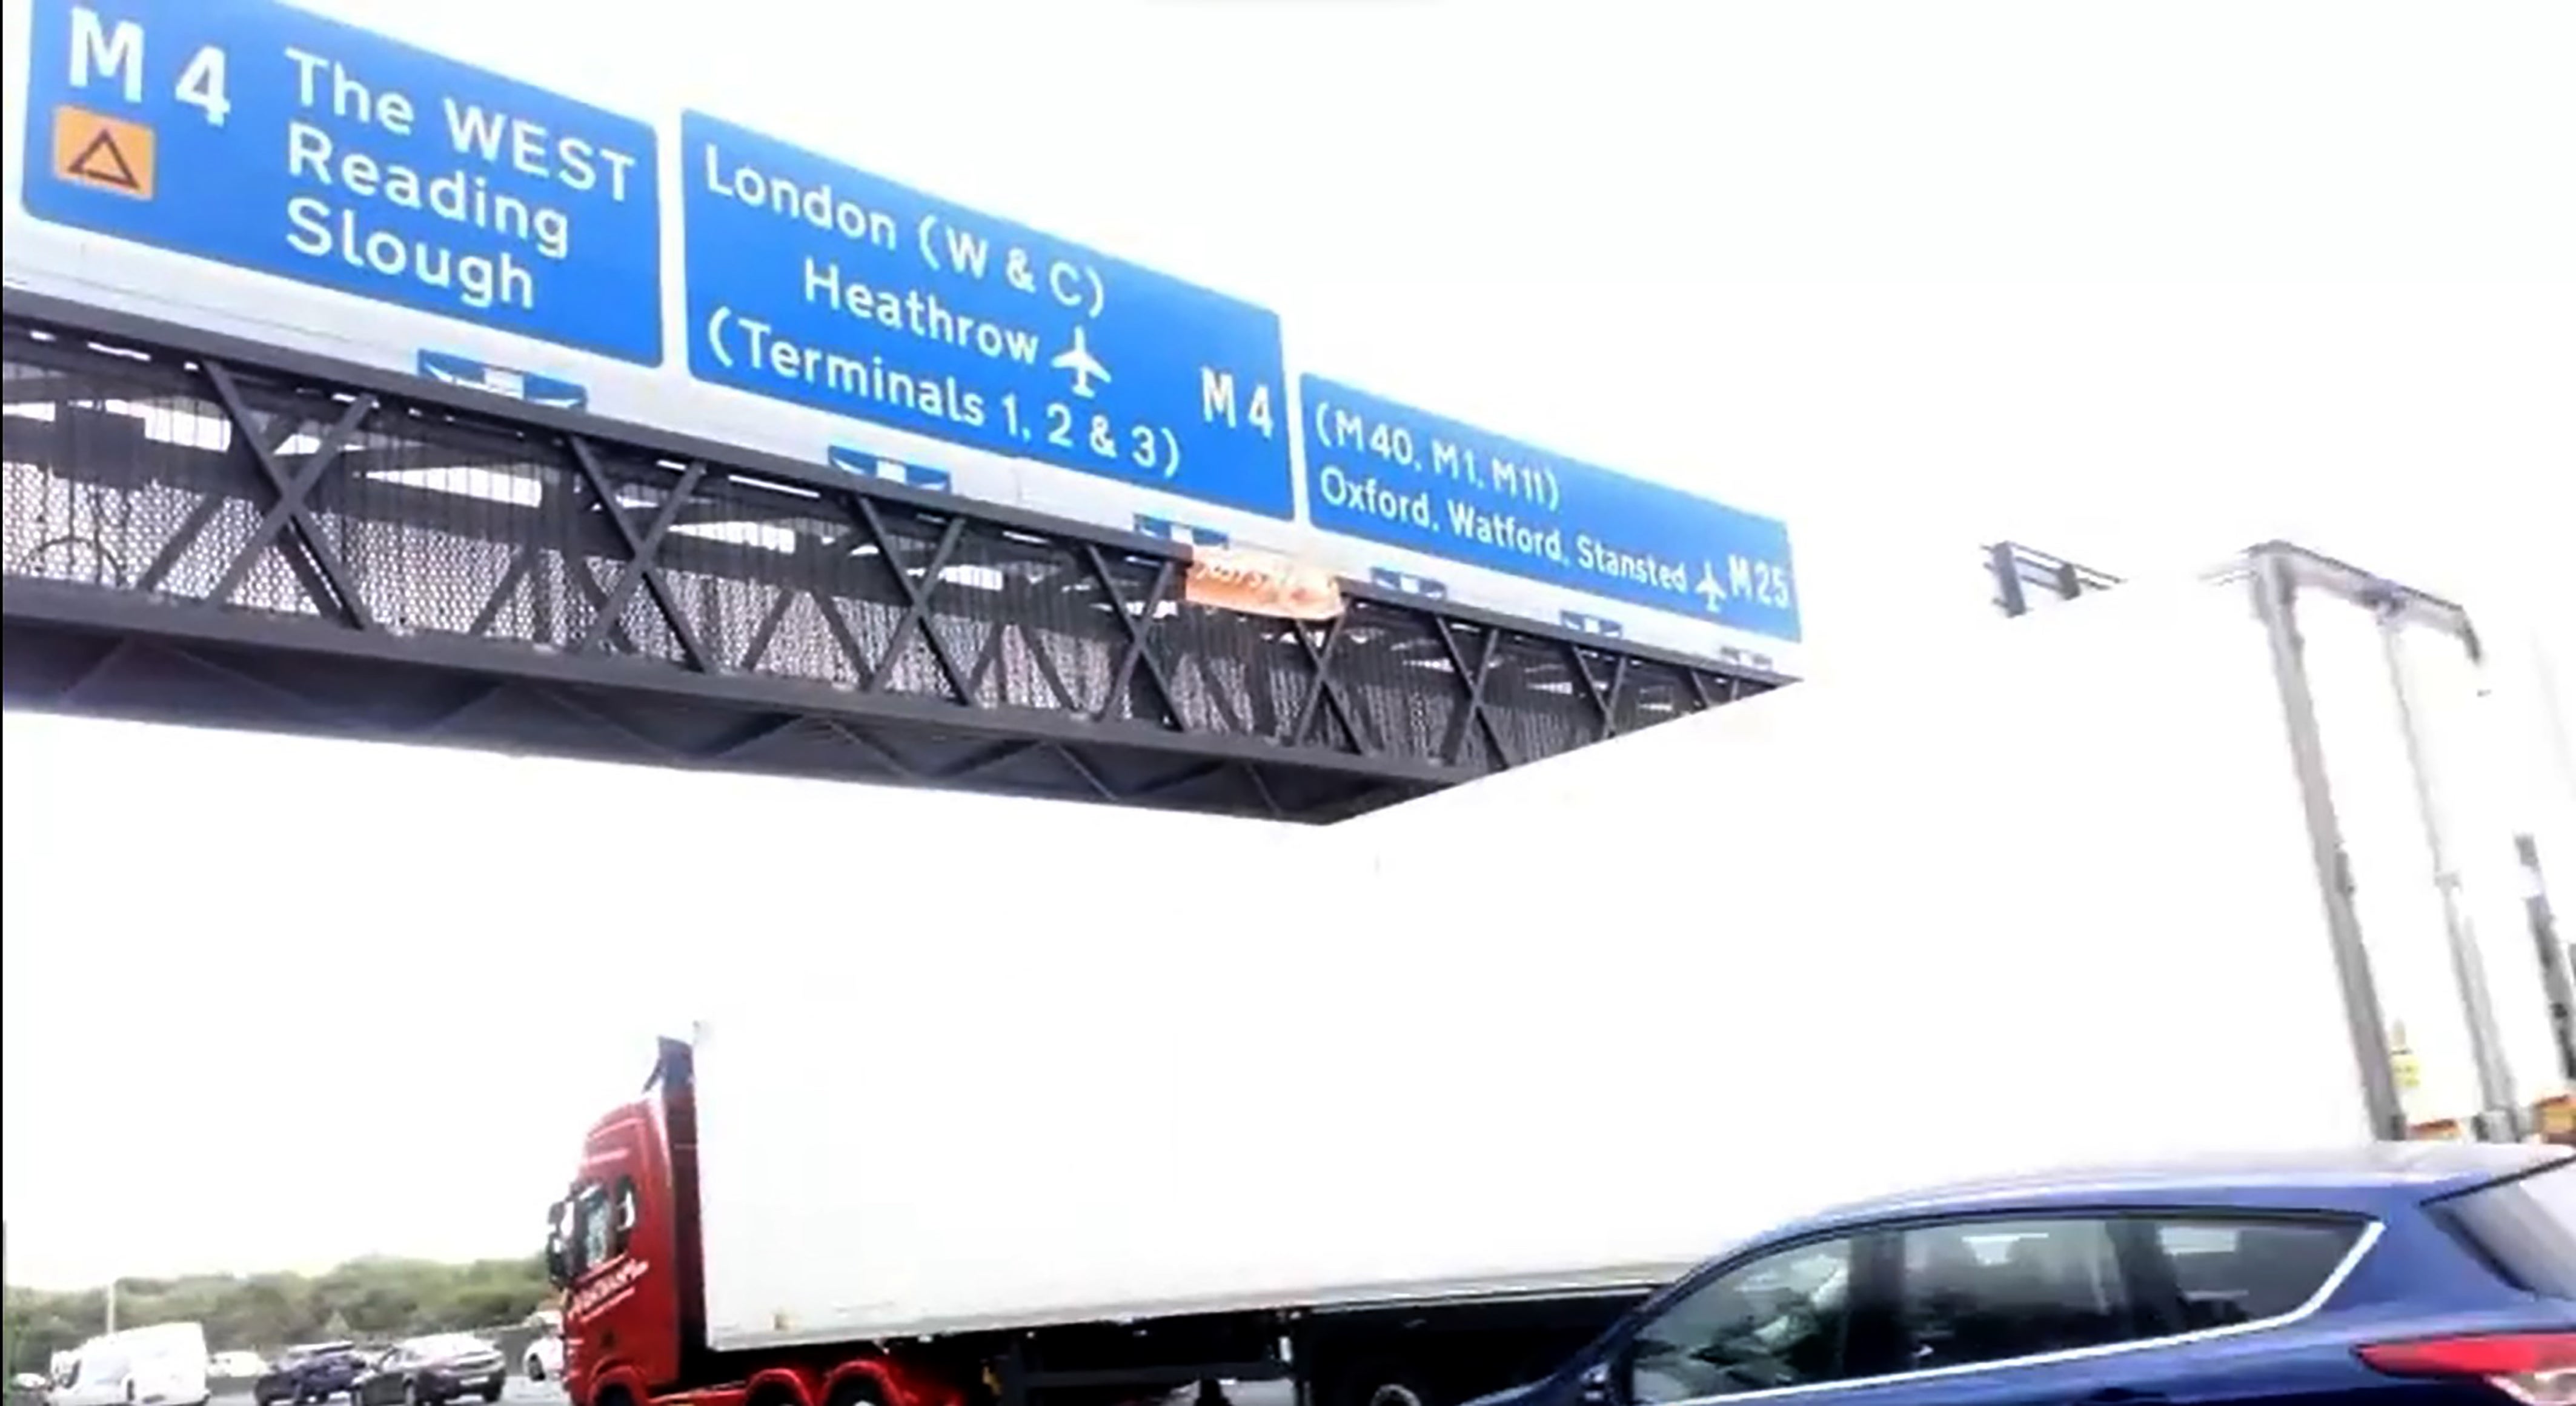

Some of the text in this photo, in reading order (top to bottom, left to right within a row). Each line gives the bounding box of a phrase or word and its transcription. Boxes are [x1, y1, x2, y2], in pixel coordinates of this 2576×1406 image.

[285, 48, 636, 201] The WEST
[288, 121, 568, 259] Reading
[287, 197, 533, 308] Slough
[706, 145, 1104, 318] London (W & C)
[805, 257, 1039, 364] Heathrow
[708, 306, 985, 427] (Terminals
[1047, 402, 1072, 447] 2
[1089, 414, 1117, 458] &
[1131, 425, 1180, 477] 3)
[1576, 535, 1687, 591] Stansted
